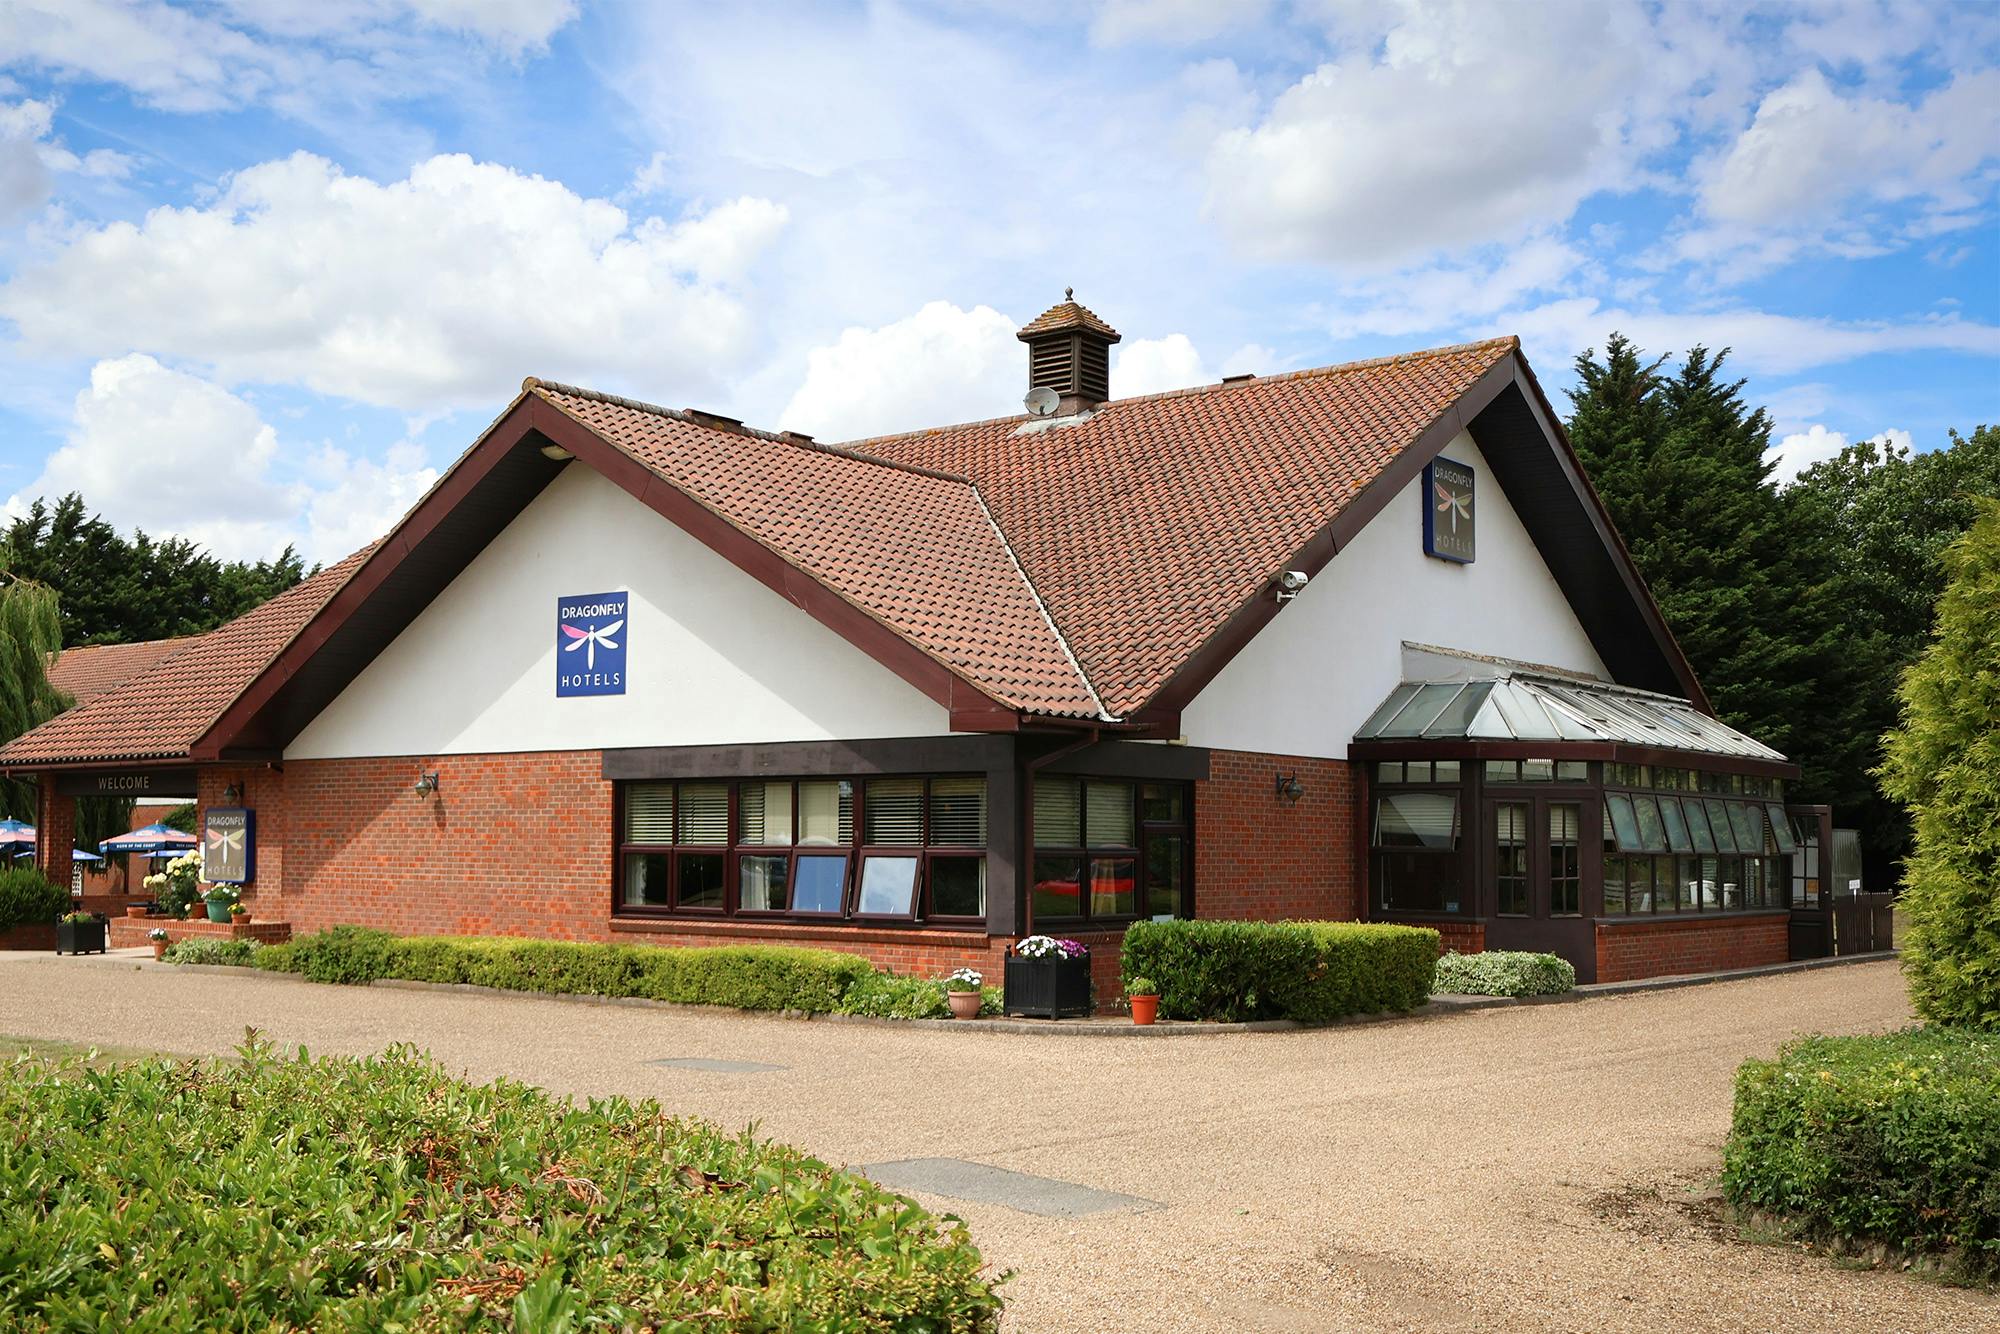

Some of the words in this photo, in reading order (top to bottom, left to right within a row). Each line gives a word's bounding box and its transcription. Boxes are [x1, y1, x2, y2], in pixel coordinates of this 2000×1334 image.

[1434, 467, 1473, 488] DRAGONFLY
[1436, 536, 1472, 553] HOTELS
[562, 603, 625, 619] DRAGONFLY
[562, 673, 620, 687] HOTELS
[98, 776, 150, 790] WELCOME
[207, 816, 246, 826] DRAGONFLY
[207, 866, 243, 875] HOTELS
